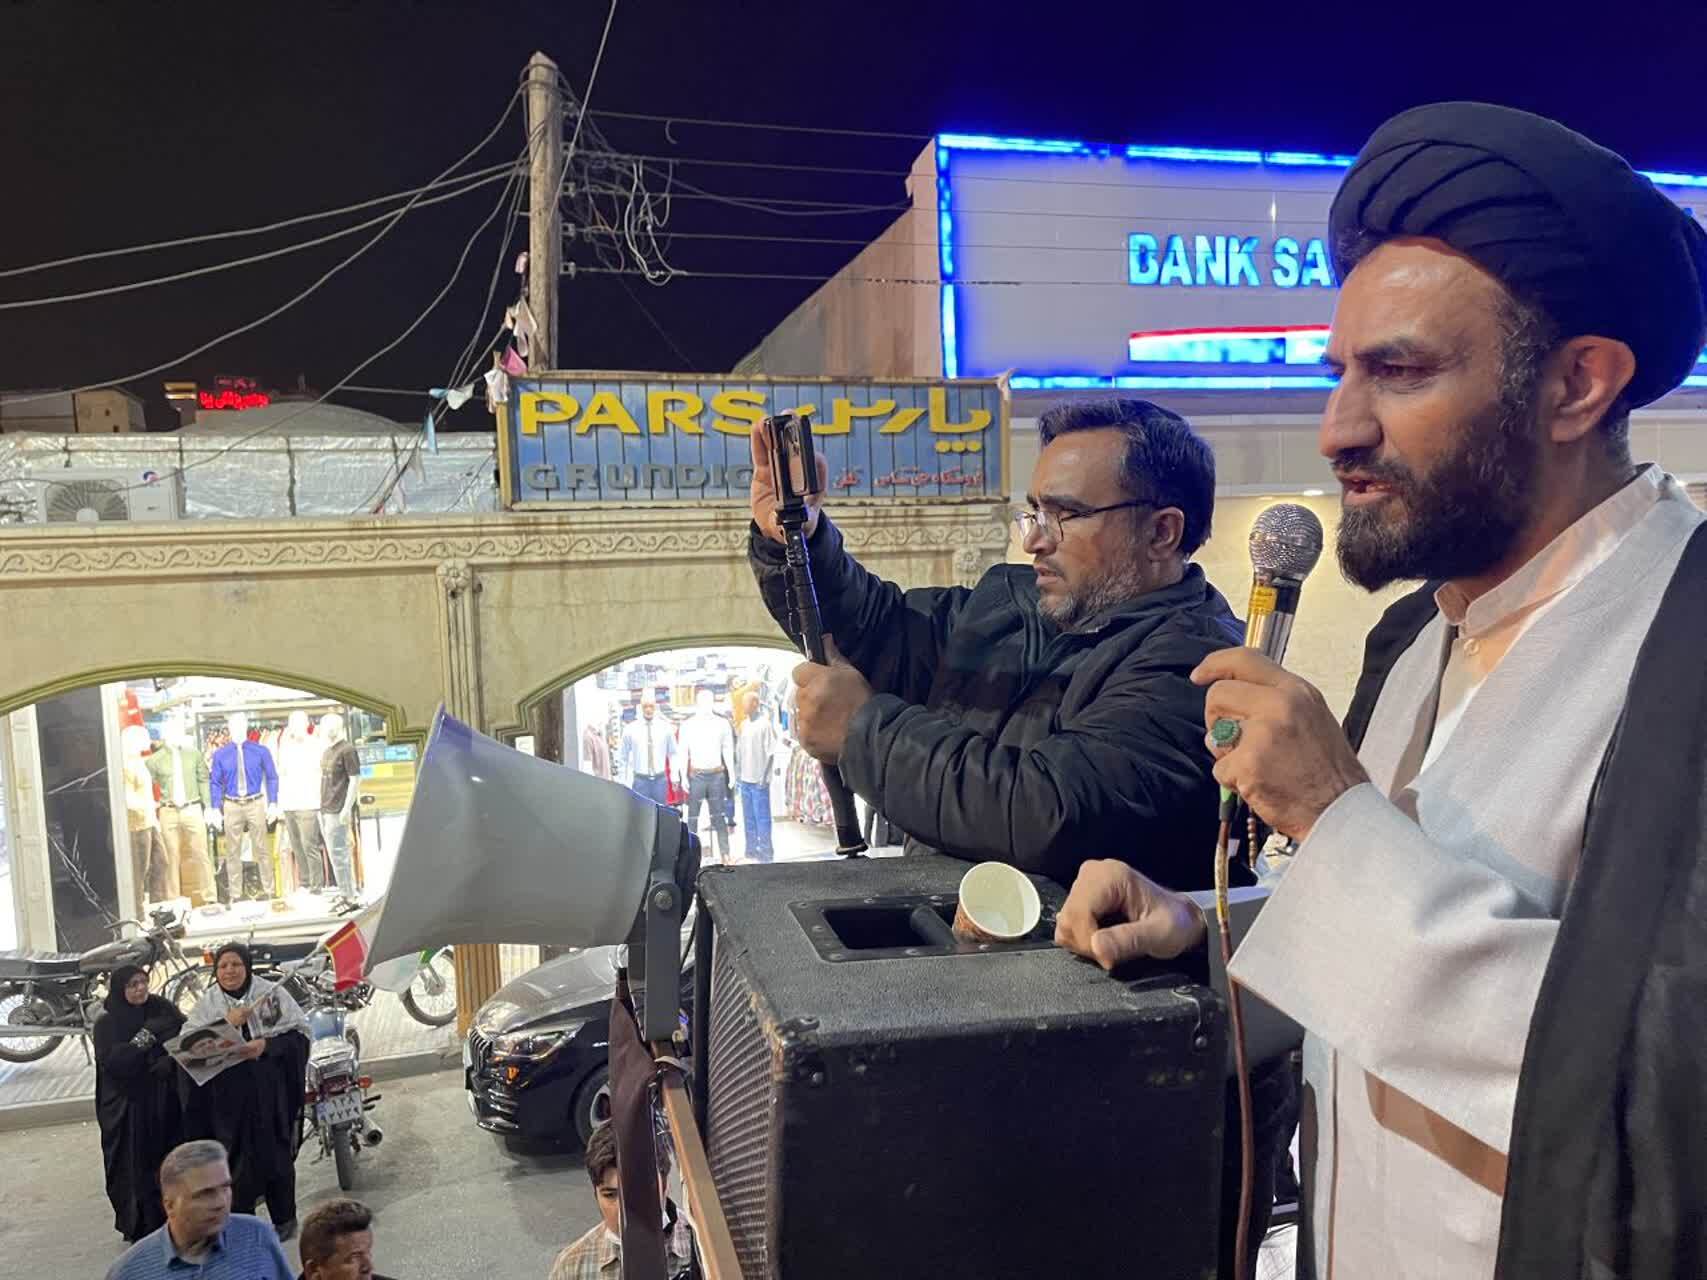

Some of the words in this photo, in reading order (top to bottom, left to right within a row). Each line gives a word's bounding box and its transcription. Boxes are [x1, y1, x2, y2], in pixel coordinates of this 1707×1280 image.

[1128, 232, 1261, 287] BANK
[1271, 236, 1334, 288] SA
[519, 391, 767, 435] PARS
[795, 387, 992, 453] پارس
